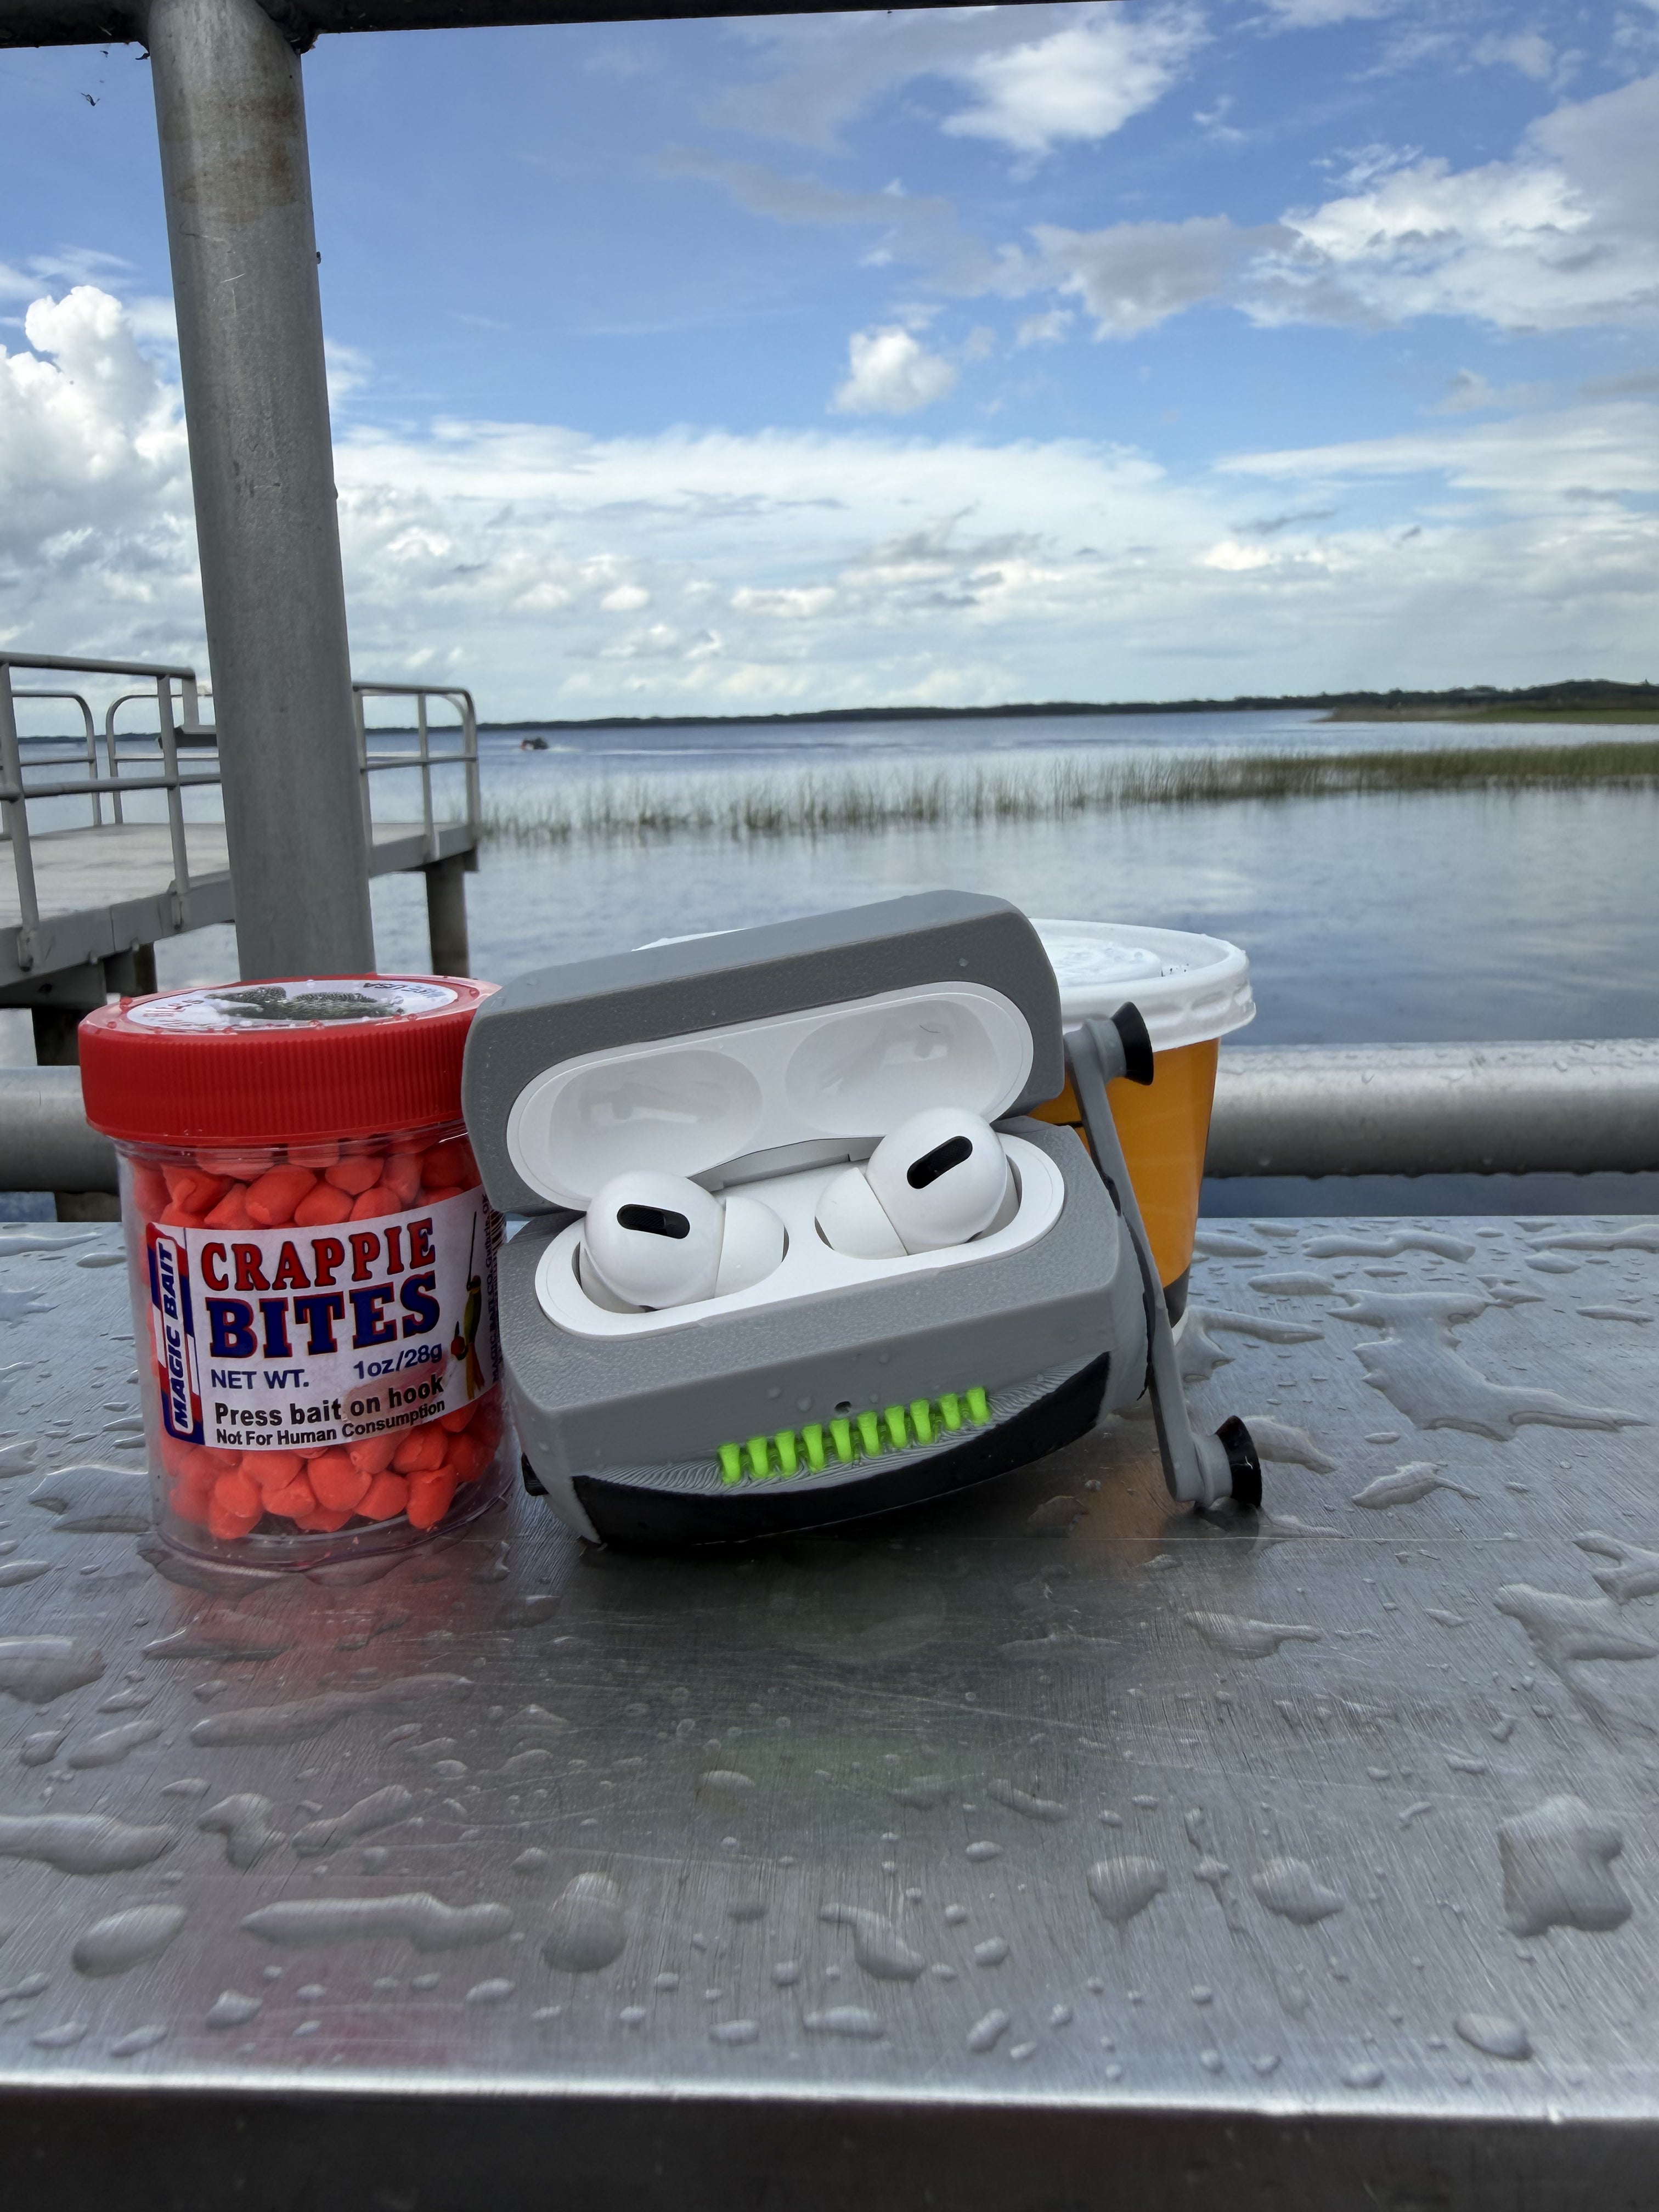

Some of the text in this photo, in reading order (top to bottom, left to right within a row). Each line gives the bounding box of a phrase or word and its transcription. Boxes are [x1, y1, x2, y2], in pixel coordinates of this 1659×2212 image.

[201, 1217, 437, 1291] CRAPPIE
[158, 1242, 188, 1429] MAGIC BAIT
[205, 1270, 441, 1359] BITES
[211, 1369, 309, 1389] NET WT.
[353, 1342, 443, 1379] 1oz/28g
[215, 1374, 444, 1426] Press bait on hook
[216, 1400, 445, 1446] Not For Human Consumption
